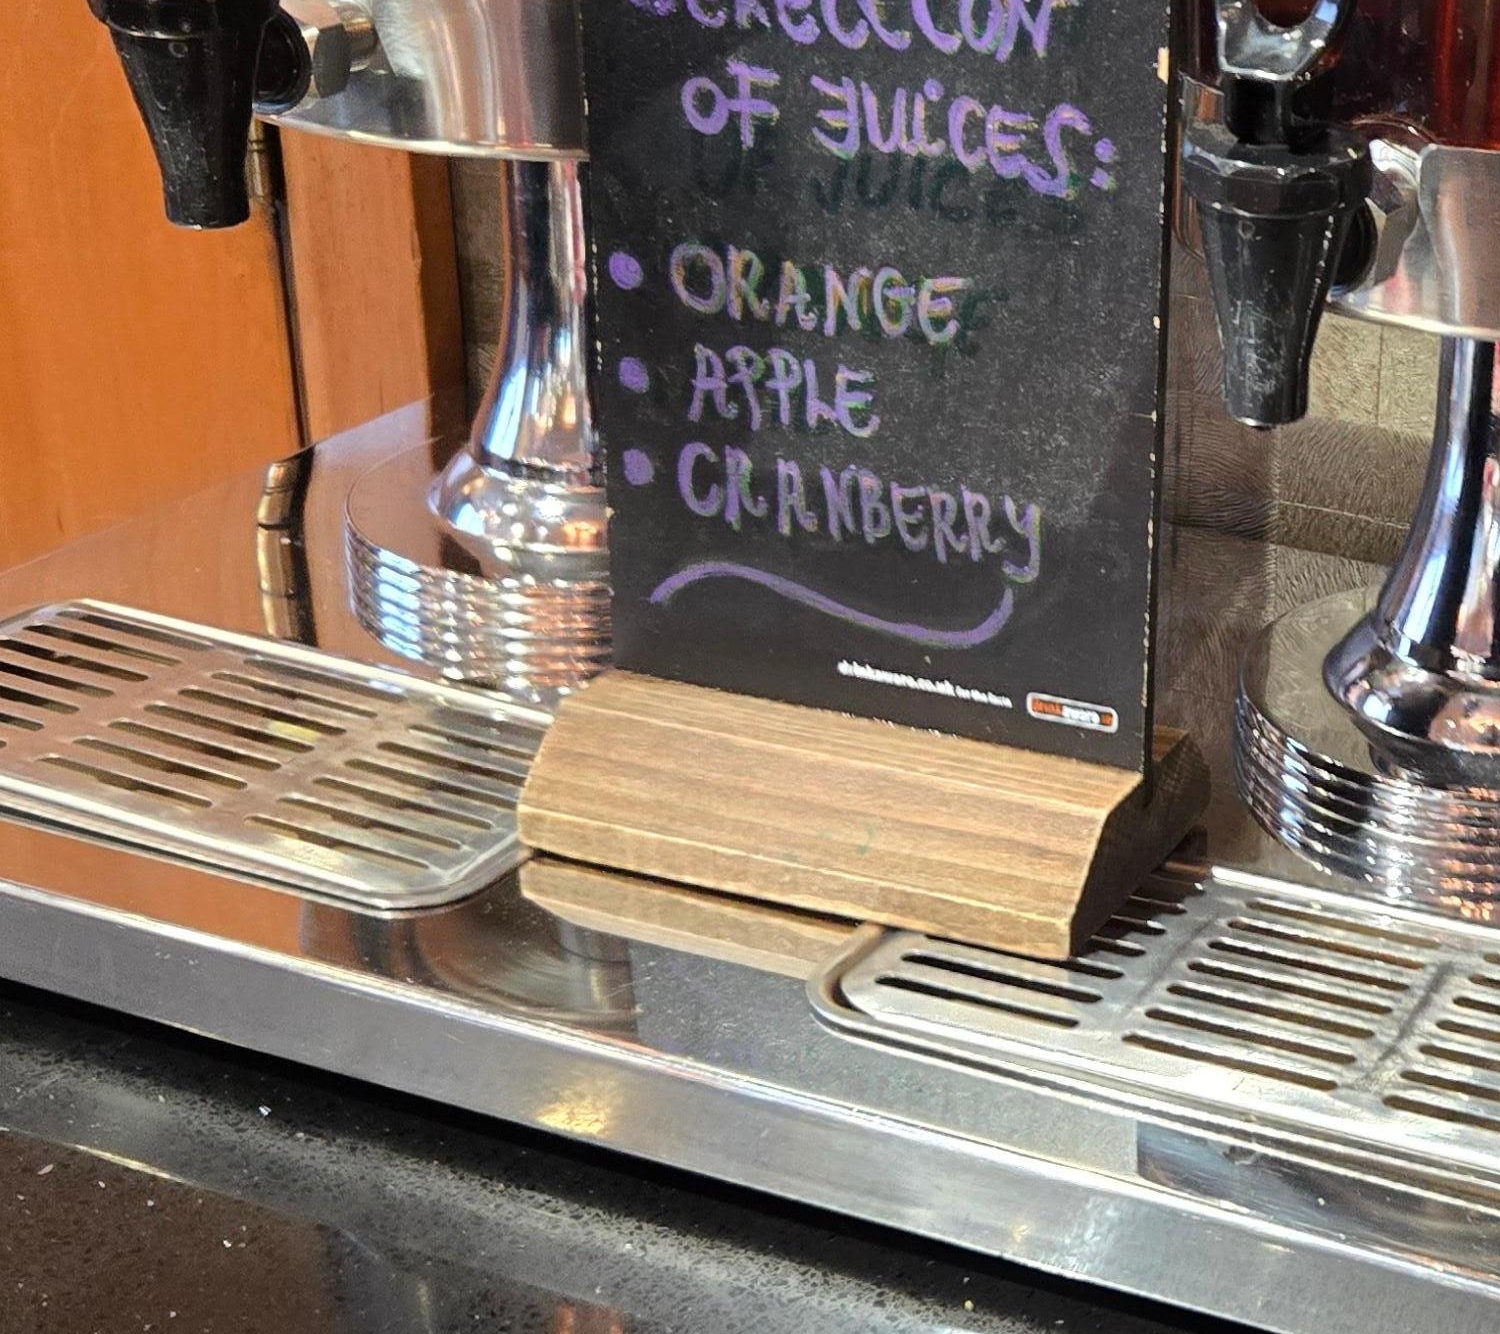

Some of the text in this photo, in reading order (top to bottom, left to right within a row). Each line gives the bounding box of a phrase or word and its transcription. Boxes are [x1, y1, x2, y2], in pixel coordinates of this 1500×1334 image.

[681, 58, 781, 151] OF
[668, 241, 974, 347] ORANGE
[687, 341, 882, 439] APPLE
[676, 441, 1042, 585] CRANBERRY
